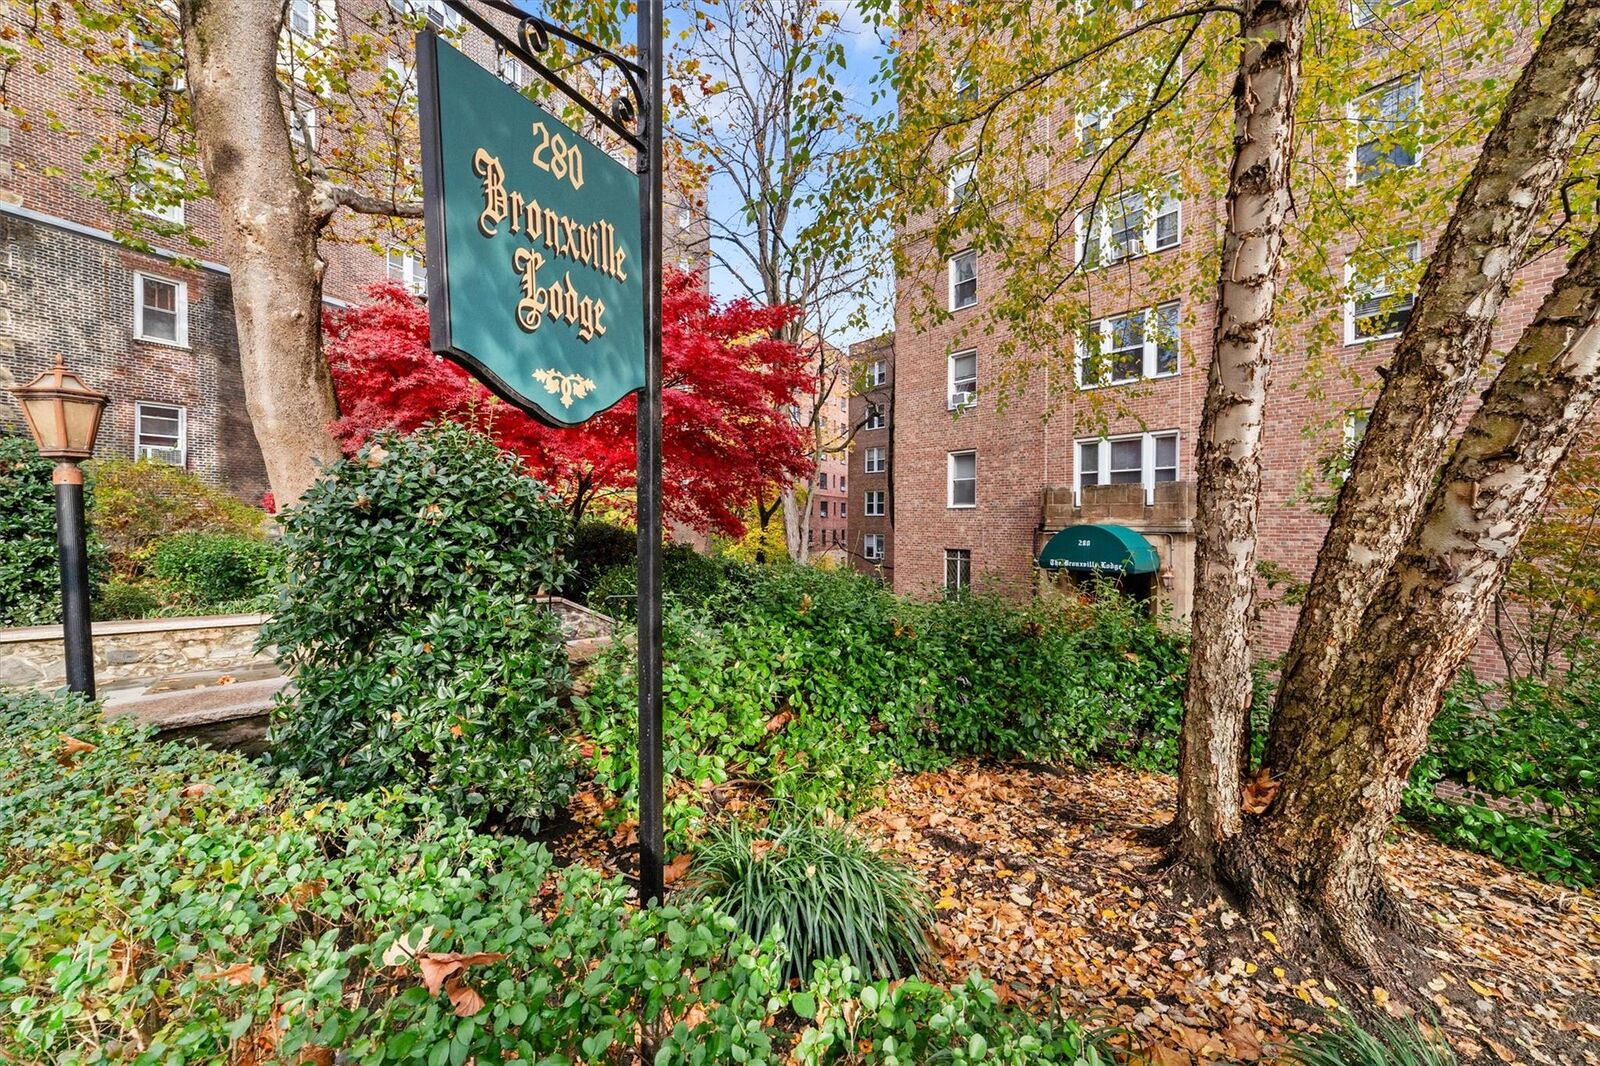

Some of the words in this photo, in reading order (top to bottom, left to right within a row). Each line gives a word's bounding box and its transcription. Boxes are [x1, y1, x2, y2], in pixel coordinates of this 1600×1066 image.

[532, 122, 584, 190] 280
[473, 147, 627, 281] Bronxville
[514, 247, 607, 341] Lodge
[1049, 559, 1062, 567] The
[1100, 561, 1123, 571] Lodge
